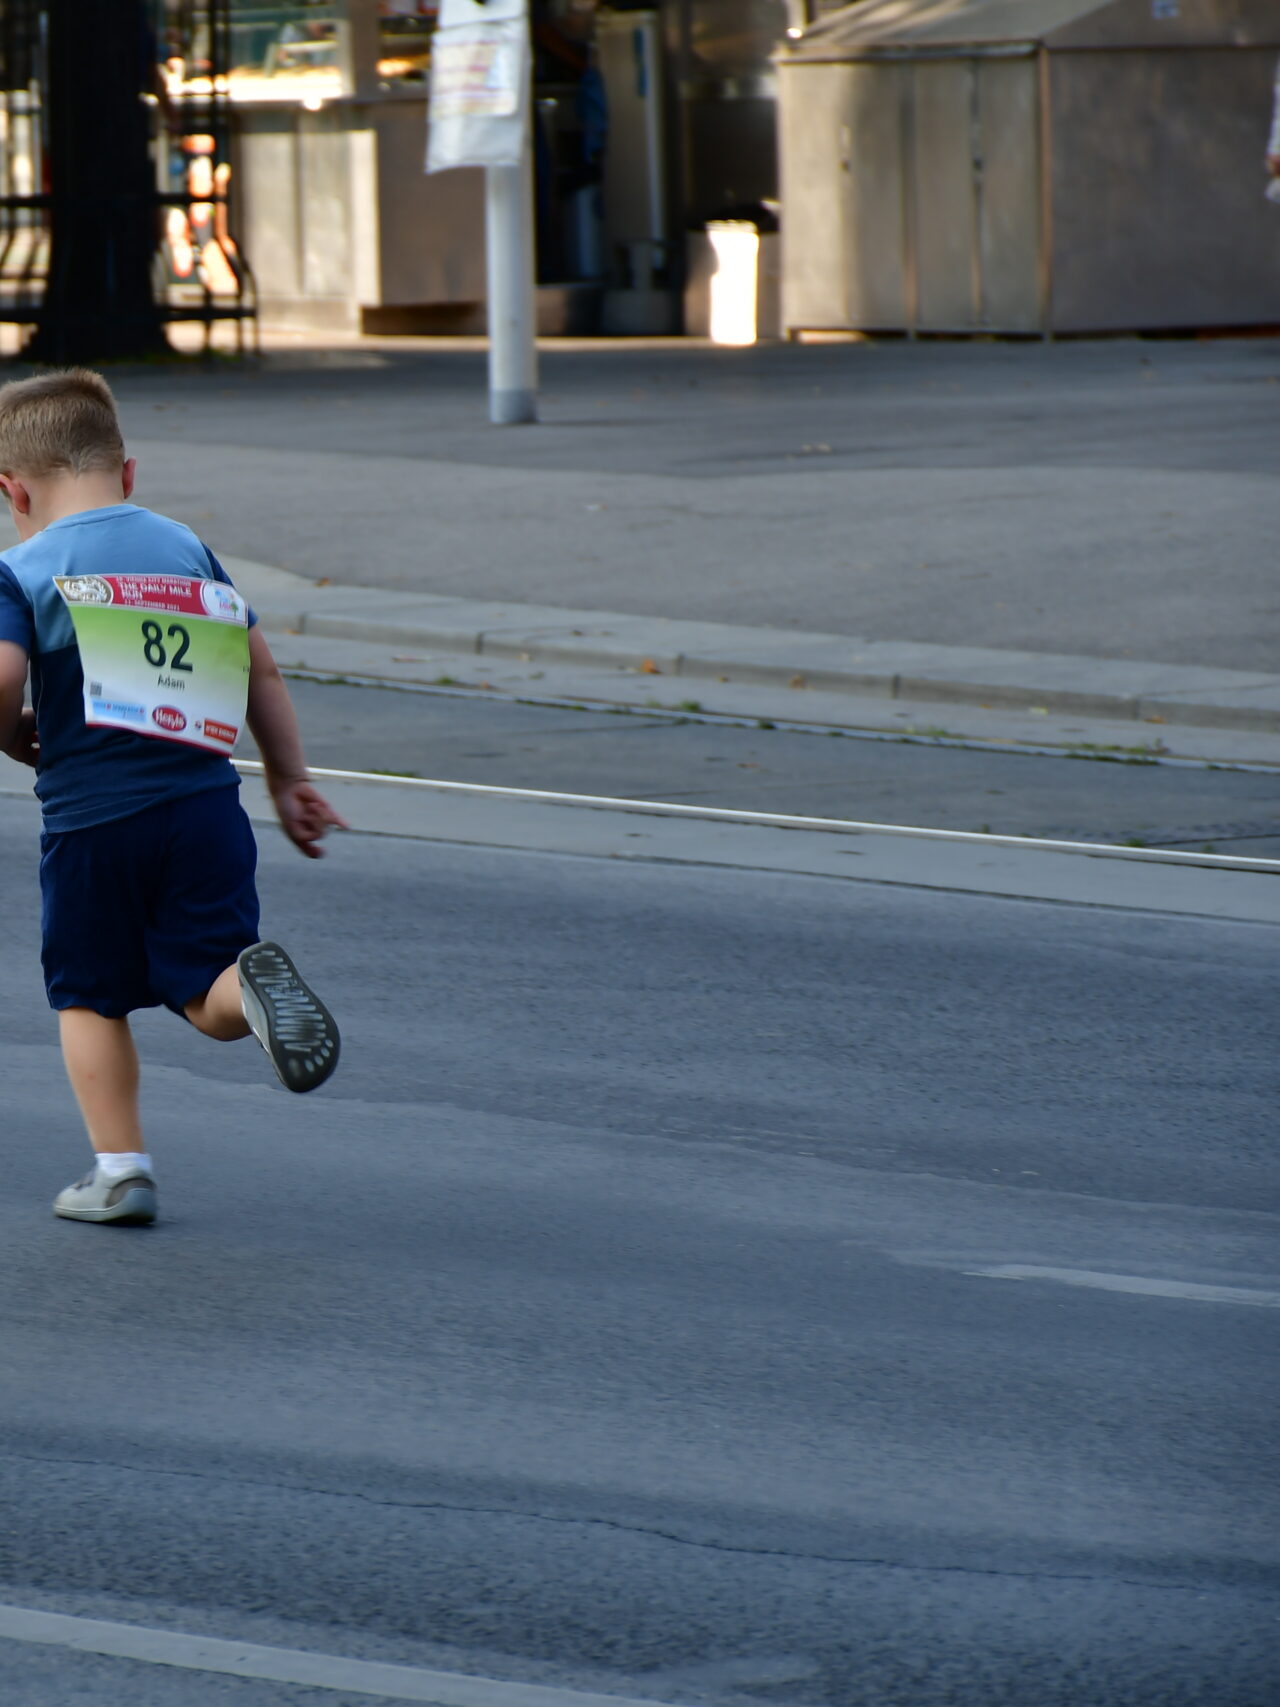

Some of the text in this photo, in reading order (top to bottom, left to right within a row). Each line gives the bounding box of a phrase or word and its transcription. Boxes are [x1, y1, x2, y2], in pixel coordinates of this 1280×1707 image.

[141, 583, 167, 594] DAILY
[169, 584, 193, 598] MILE
[141, 619, 193, 673] 82
[157, 674, 186, 691] Adam
